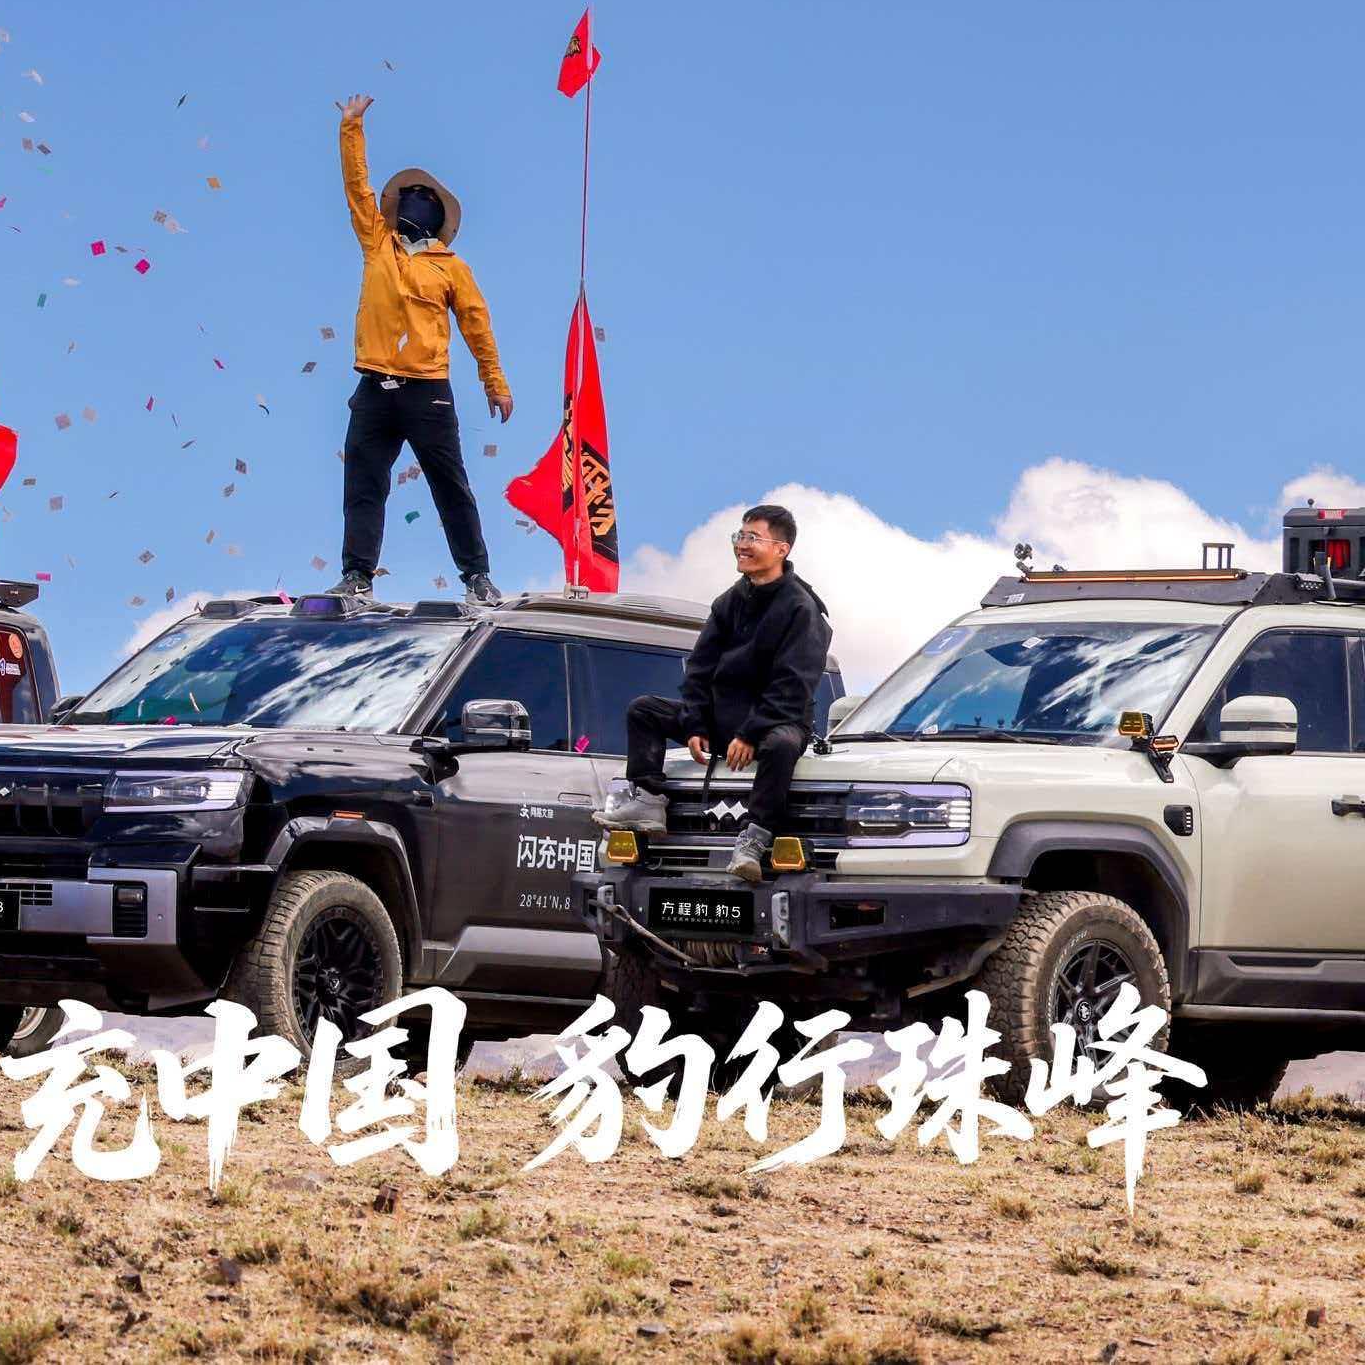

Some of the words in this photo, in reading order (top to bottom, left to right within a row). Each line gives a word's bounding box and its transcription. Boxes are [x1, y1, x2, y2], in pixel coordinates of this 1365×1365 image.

[516, 833, 597, 873] 闪充中国
[661, 901, 709, 917] 方程豹
[715, 903, 742, 919] 豹5
